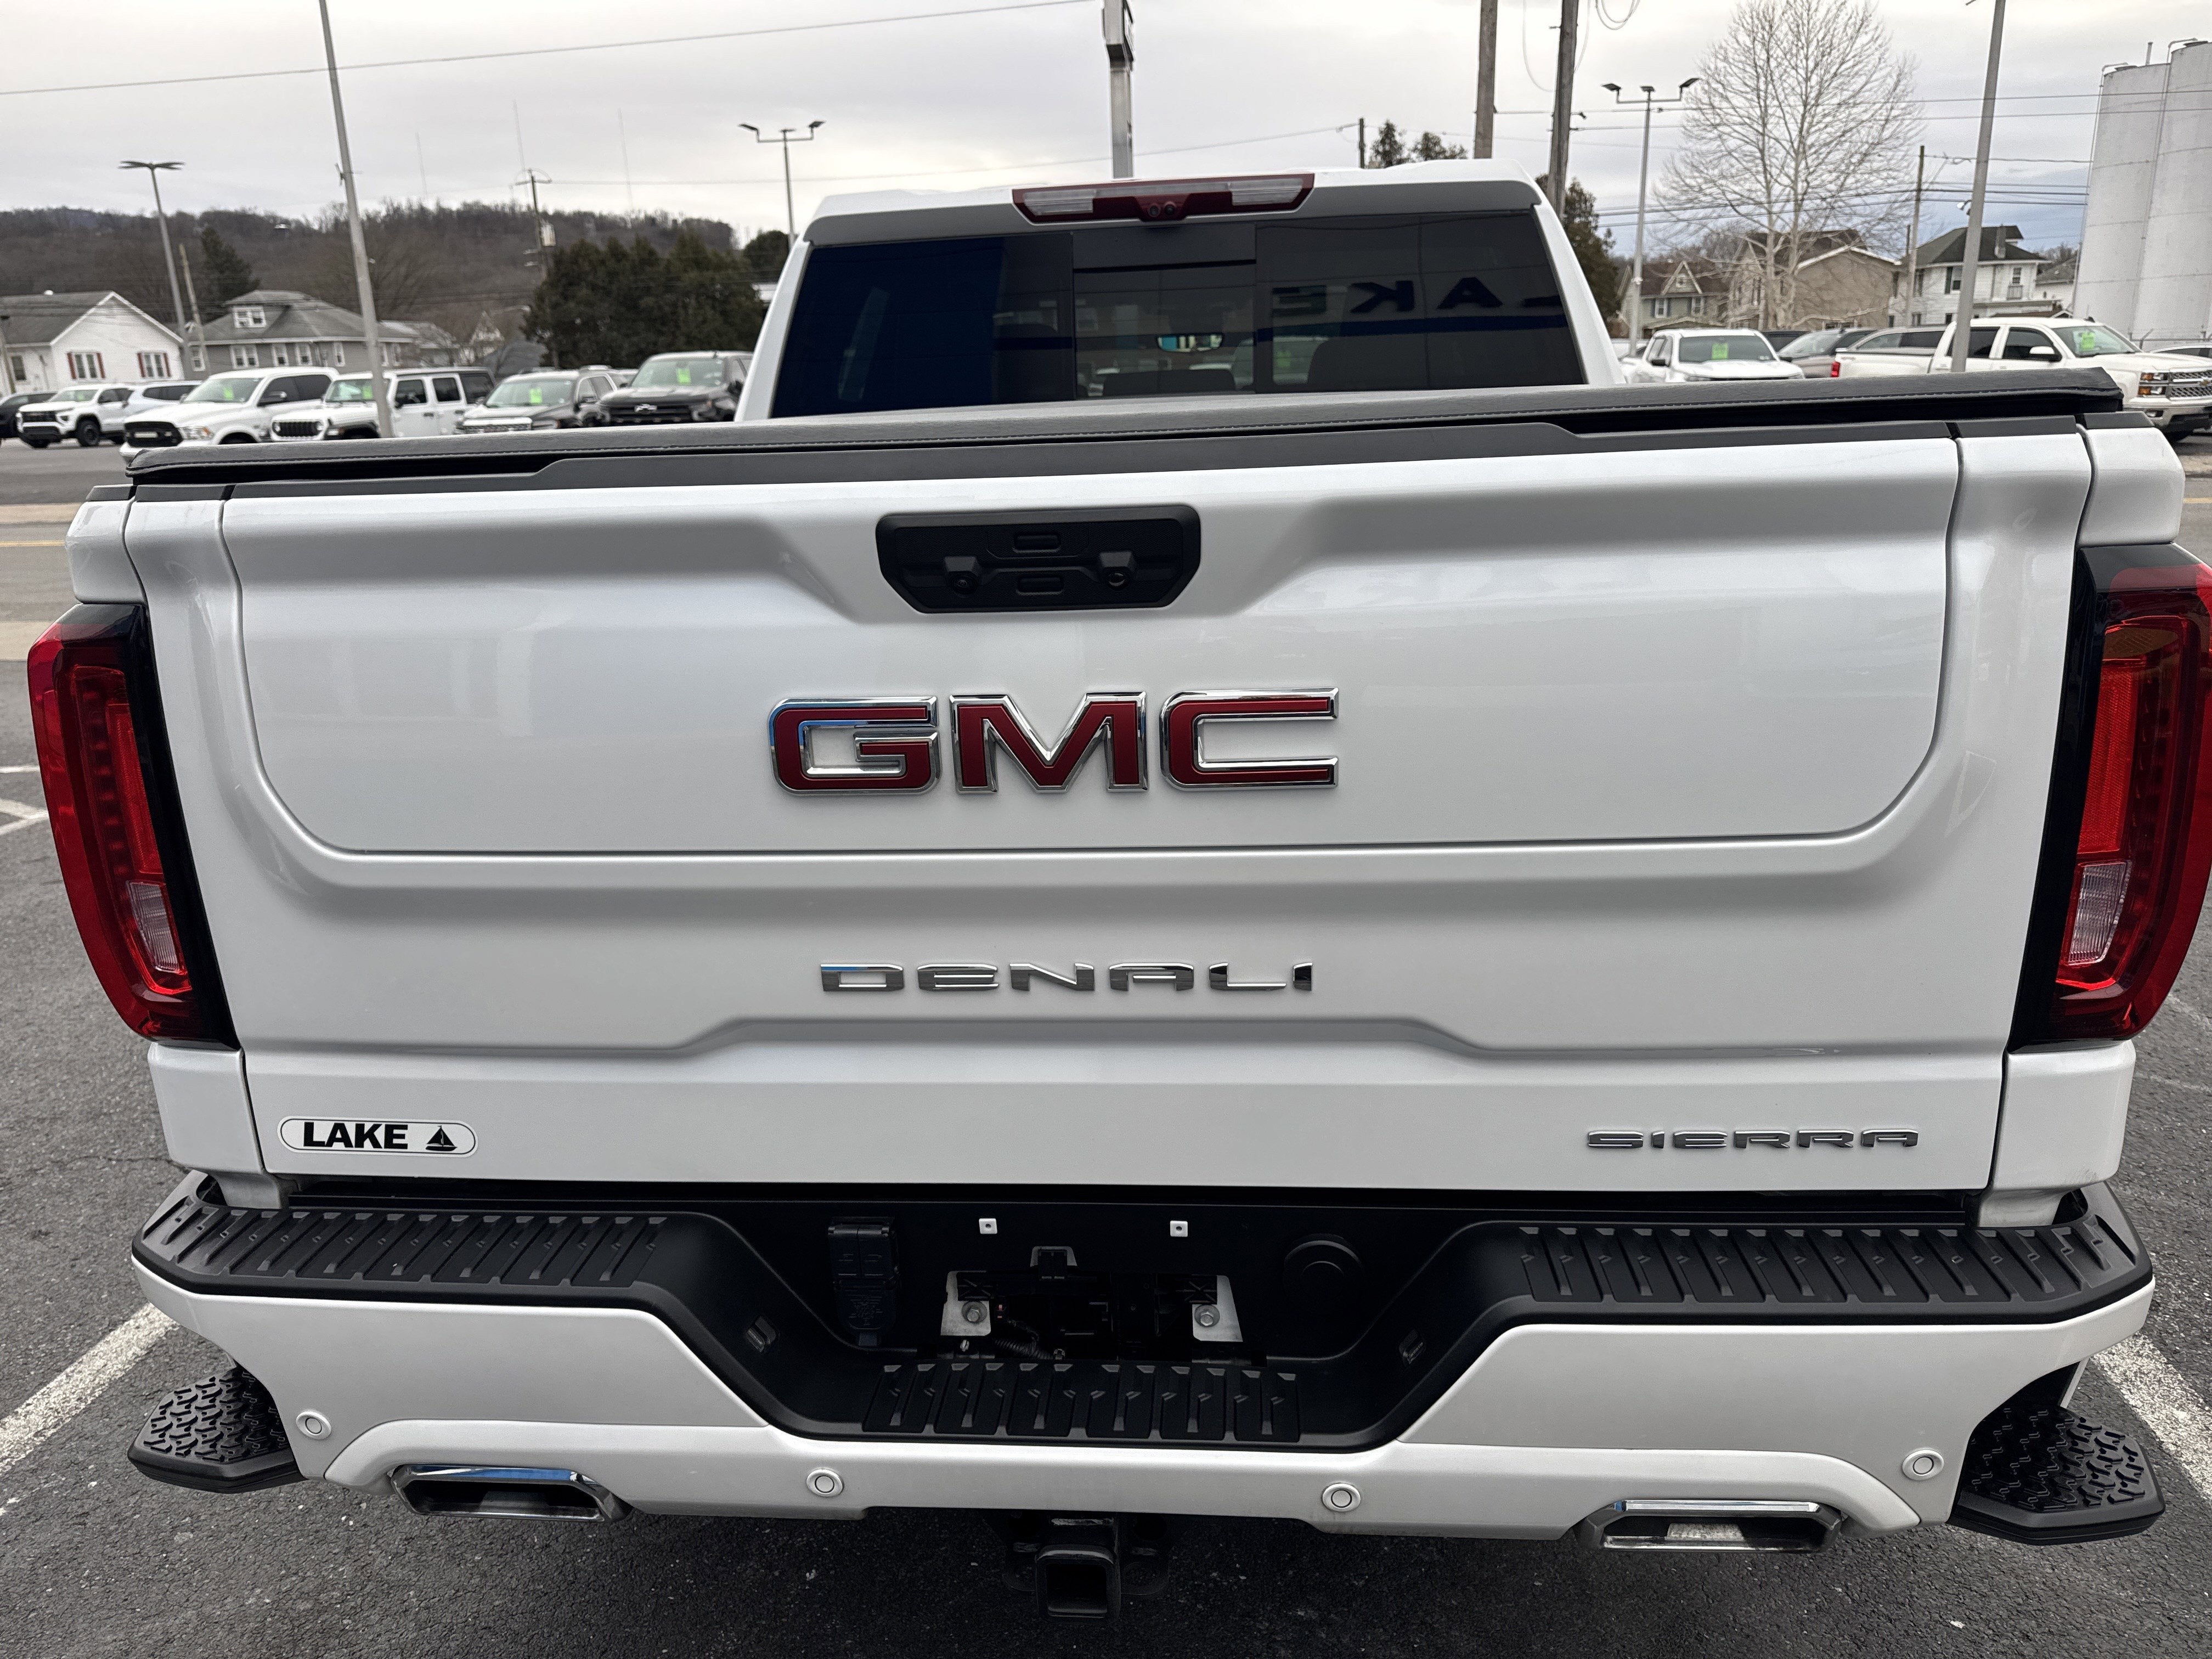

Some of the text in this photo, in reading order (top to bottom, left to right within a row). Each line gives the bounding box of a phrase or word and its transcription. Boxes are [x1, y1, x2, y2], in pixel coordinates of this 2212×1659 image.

[768, 687, 1339, 793] GMC
[821, 963, 1313, 991] DENALI
[303, 1121, 408, 1149] LAKE
[1588, 1129, 1919, 1149] SIERRA
